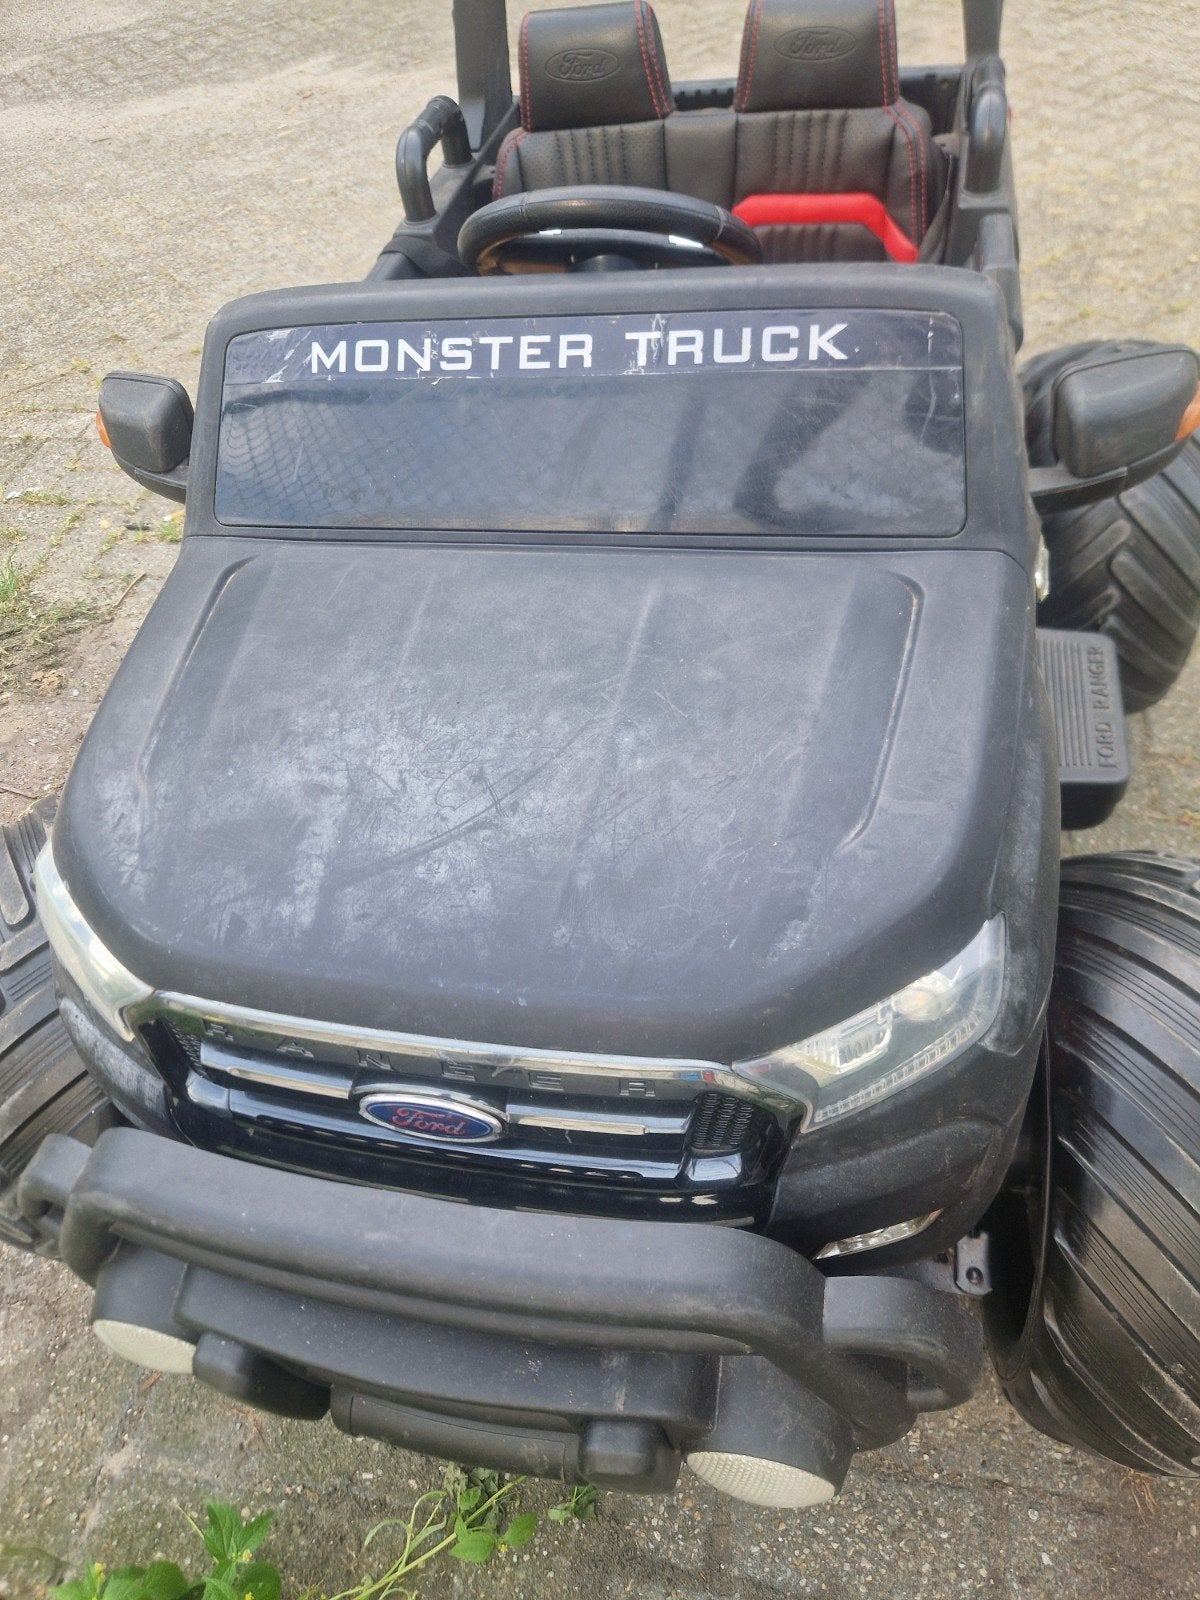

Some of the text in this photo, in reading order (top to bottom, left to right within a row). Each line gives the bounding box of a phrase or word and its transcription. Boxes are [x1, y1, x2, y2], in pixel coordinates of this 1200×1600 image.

[790, 30, 841, 57] Ford
[559, 52, 607, 78] Ford
[311, 323, 848, 374] MONSTER TRUCK
[1086, 645, 1118, 769] FORD RANGER
[201, 1017, 656, 1097] RANGER
[391, 1107, 468, 1135] Ford
